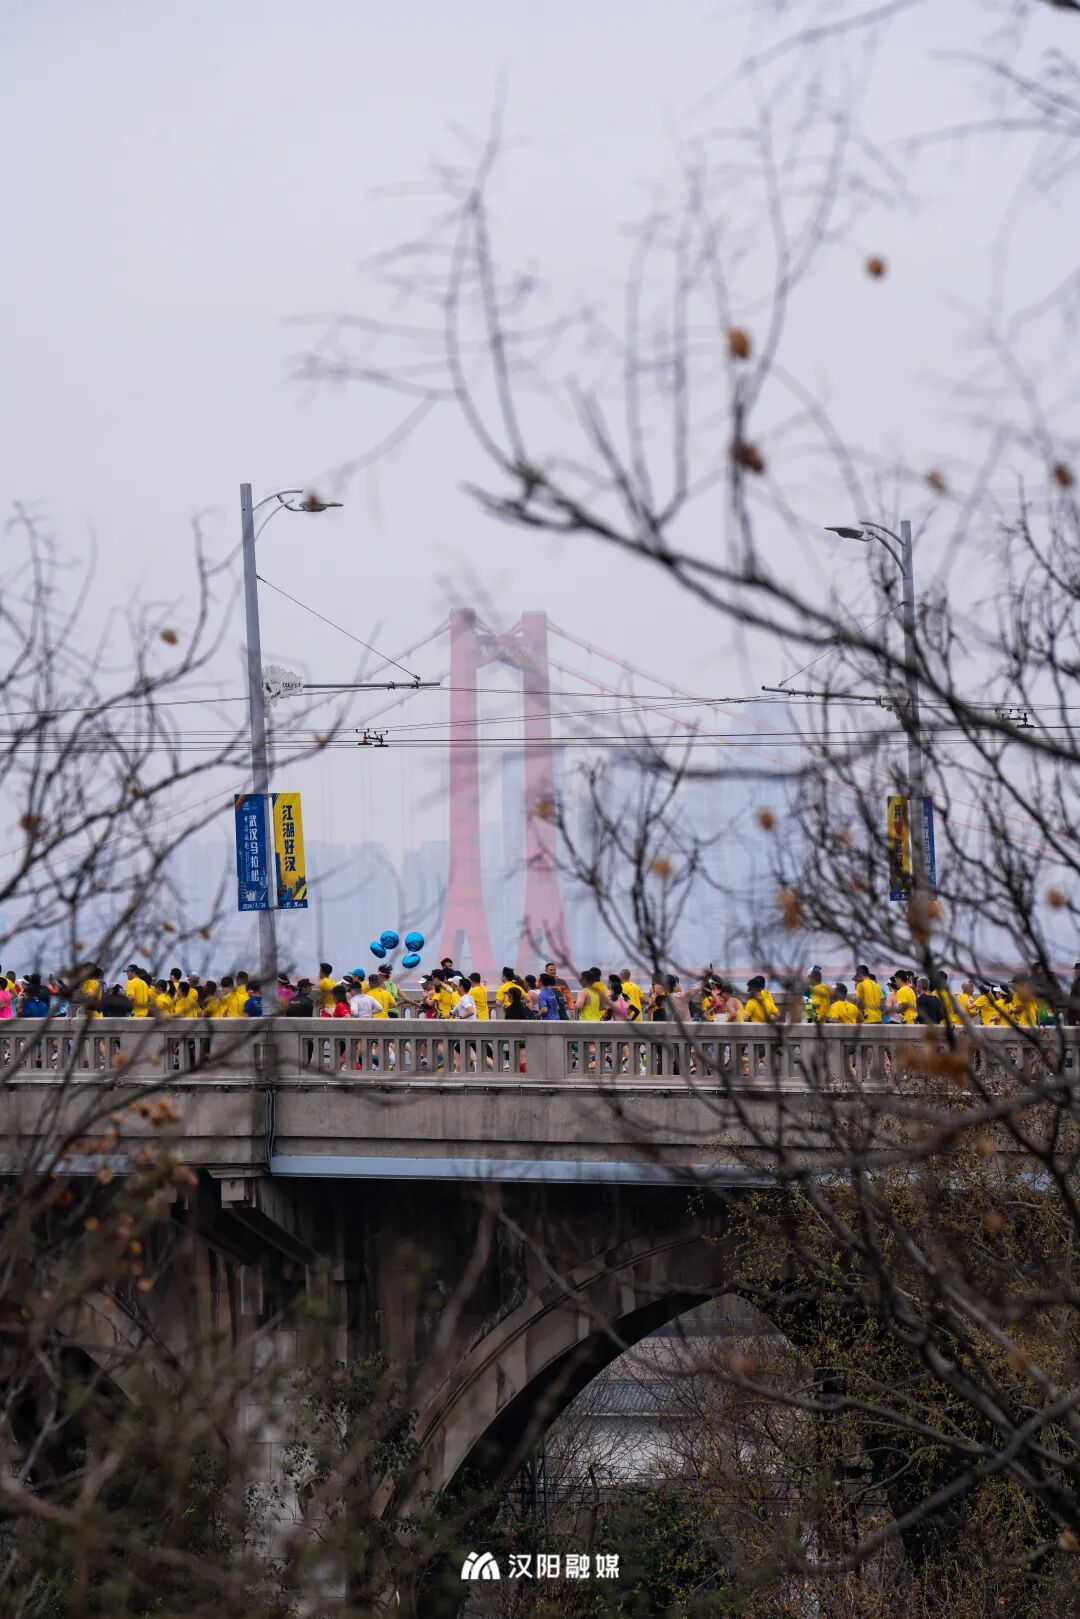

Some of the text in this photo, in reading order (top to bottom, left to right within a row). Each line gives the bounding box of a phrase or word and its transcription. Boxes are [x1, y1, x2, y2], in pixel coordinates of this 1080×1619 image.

[248, 814, 259, 882] 武汉马拉松
[282, 805, 296, 871] 江湖好汉
